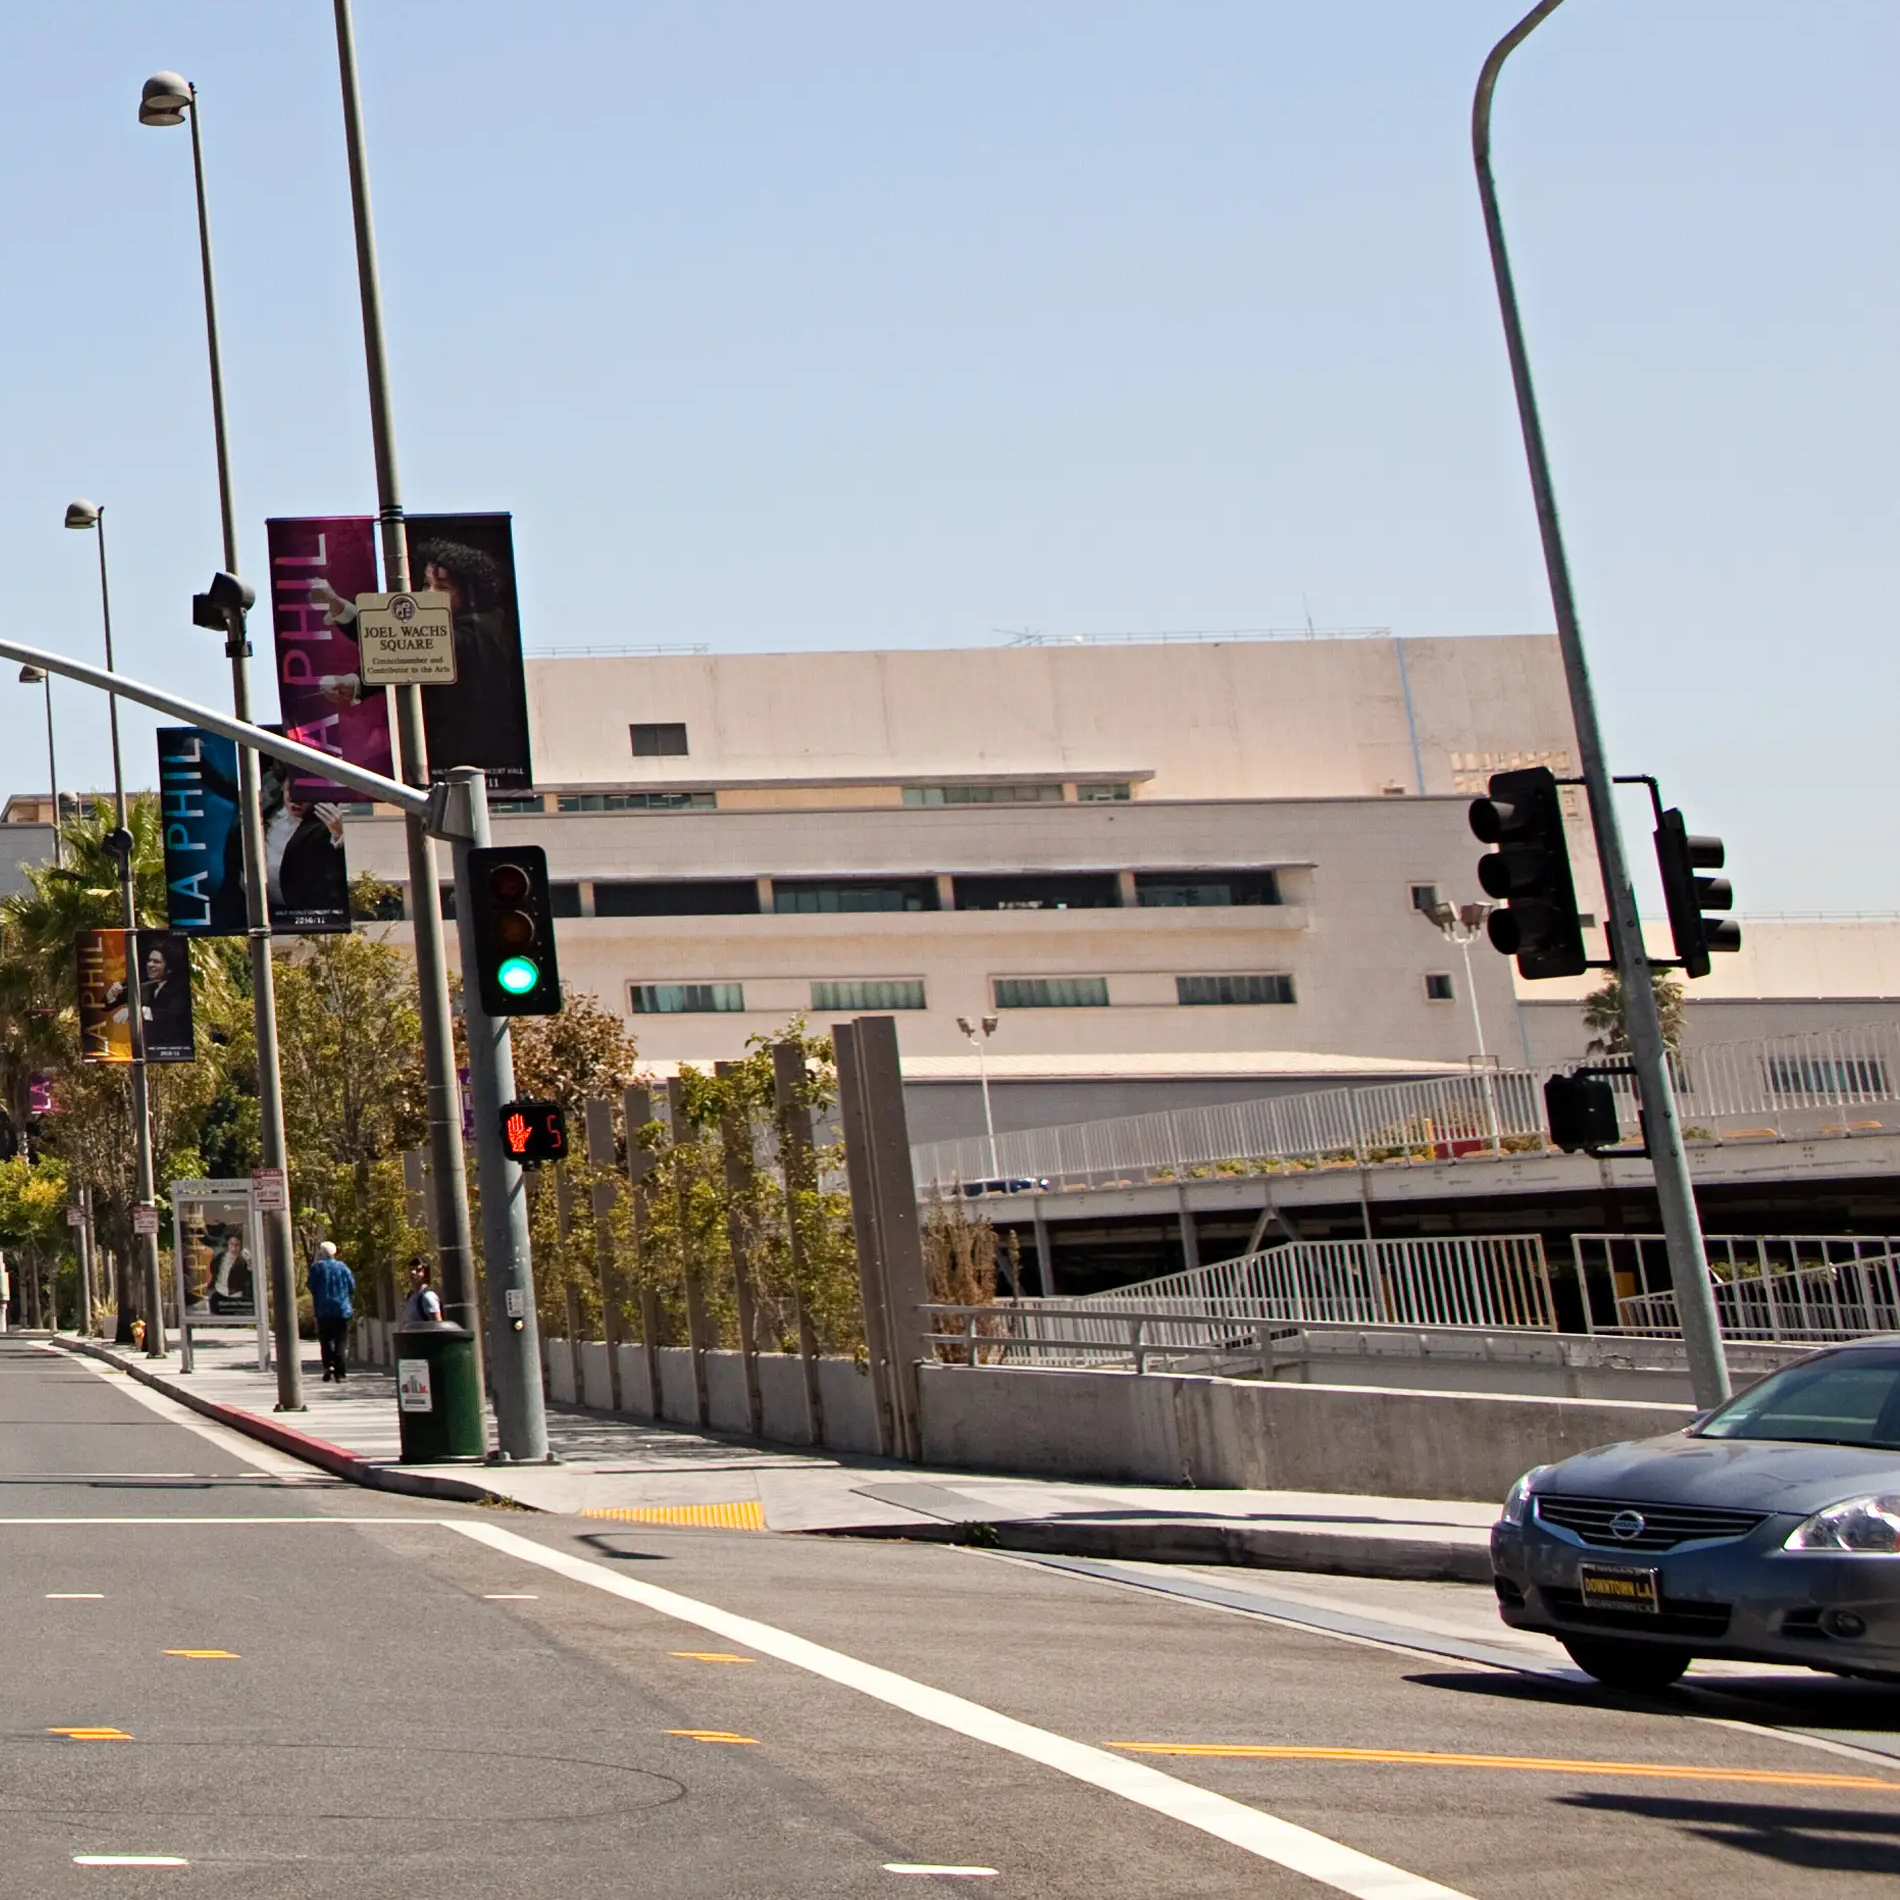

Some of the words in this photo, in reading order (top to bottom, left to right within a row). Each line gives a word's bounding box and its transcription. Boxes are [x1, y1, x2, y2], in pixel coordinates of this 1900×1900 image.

[274, 532, 333, 686] PHIL
[364, 626, 397, 638] JOEL
[400, 625, 448, 638] WACHS
[380, 639, 434, 652] SQUARE
[430, 656, 444, 664] and
[434, 665, 450, 673] Arts
[161, 737, 207, 851] PHIL
[167, 869, 212, 926] LA
[80, 936, 106, 1009] PHIL
[84, 1020, 110, 1057] LA
[546, 1115, 561, 1148] 5
[1583, 1577, 1635, 1596] DOWNTOWN
